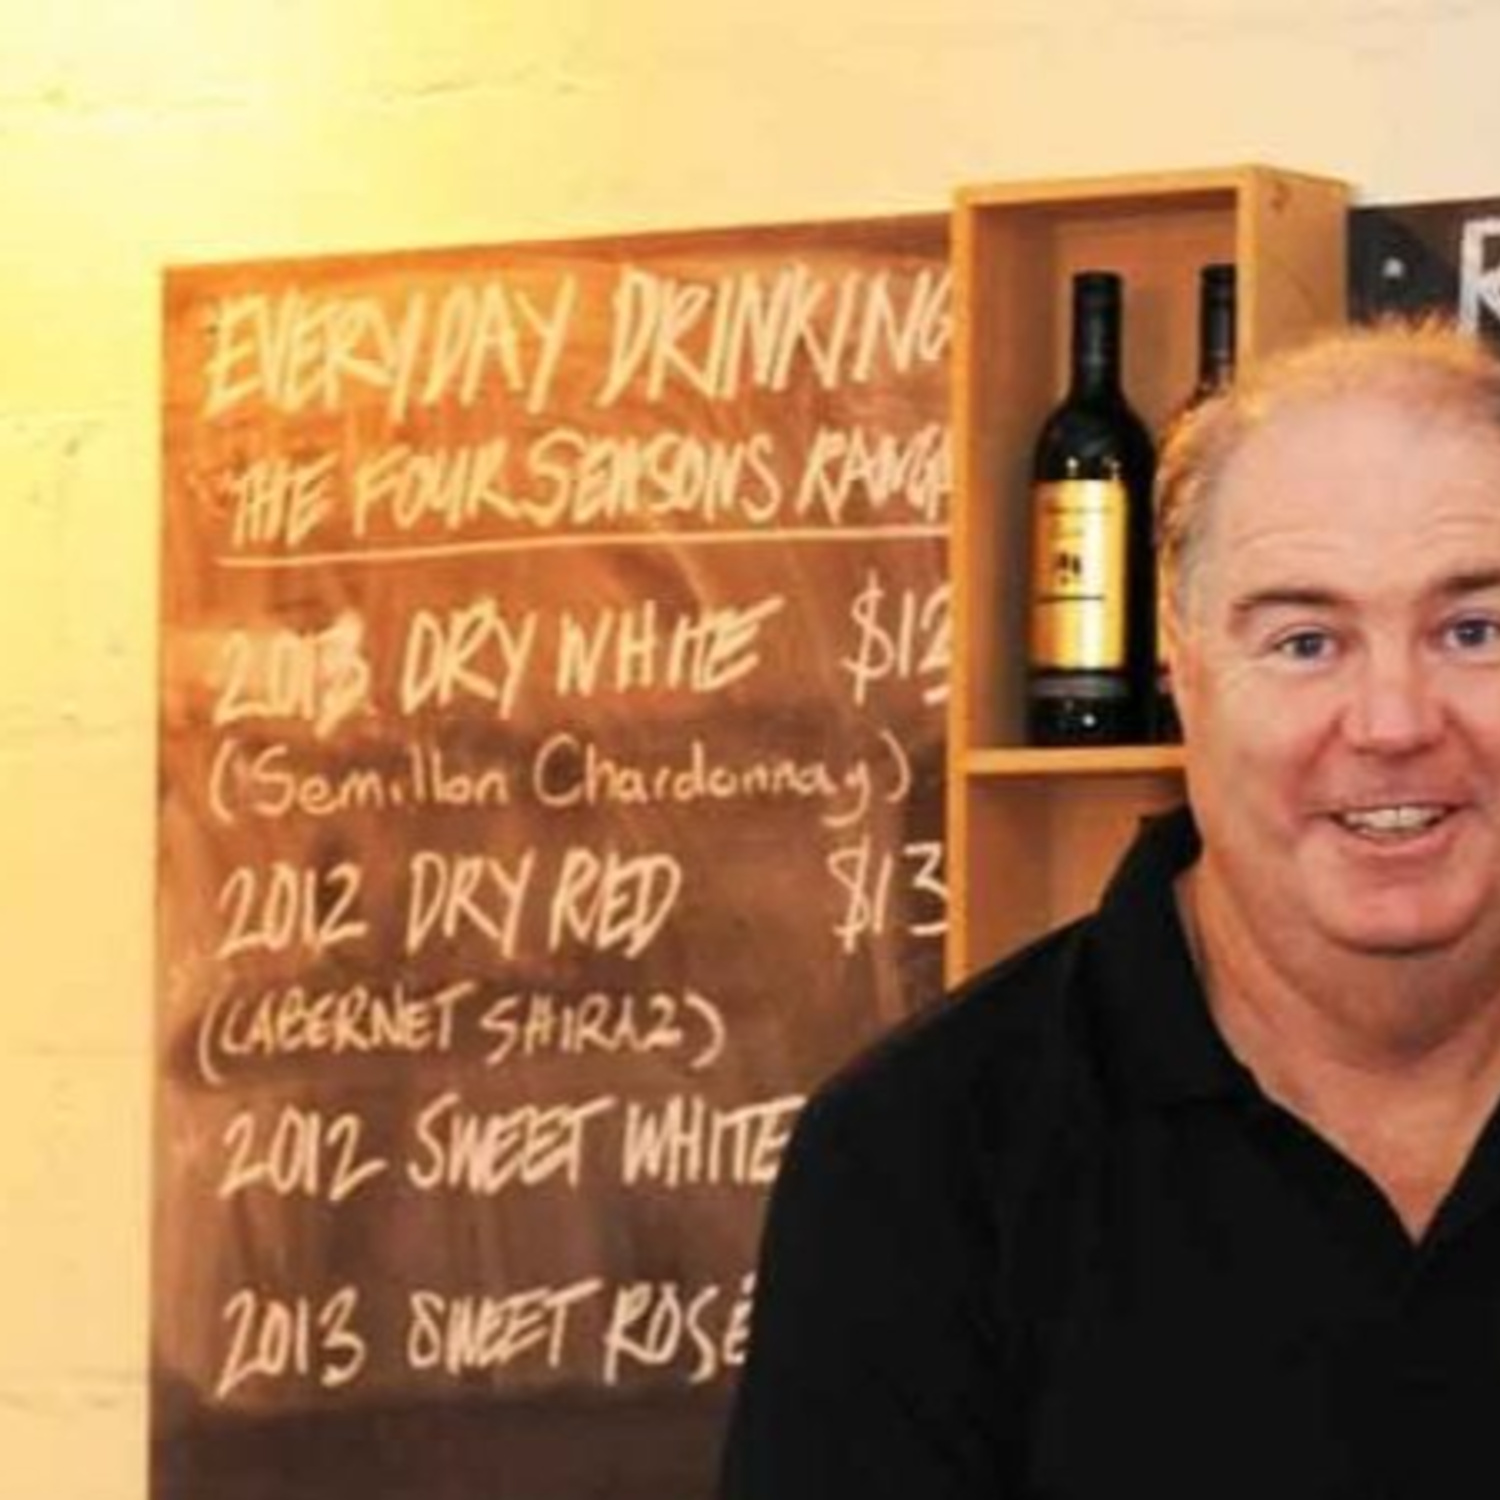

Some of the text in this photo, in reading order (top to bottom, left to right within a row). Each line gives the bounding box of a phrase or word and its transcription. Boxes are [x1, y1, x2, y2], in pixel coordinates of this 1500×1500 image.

[206, 261, 951, 421] EVERYDAY DRINKING
[232, 455, 335, 546] THE
[354, 438, 517, 535] FOUR
[511, 429, 782, 525] SEASONS
[215, 612, 372, 738] 2013
[402, 593, 536, 720] DRY
[557, 597, 785, 698] WHITE
[216, 837, 946, 958] 2012 DRY RED $13
[219, 1094, 805, 1200] 2012 SWEET WHITE
[216, 1287, 366, 1398] 2013
[408, 1278, 602, 1370] SWEET
